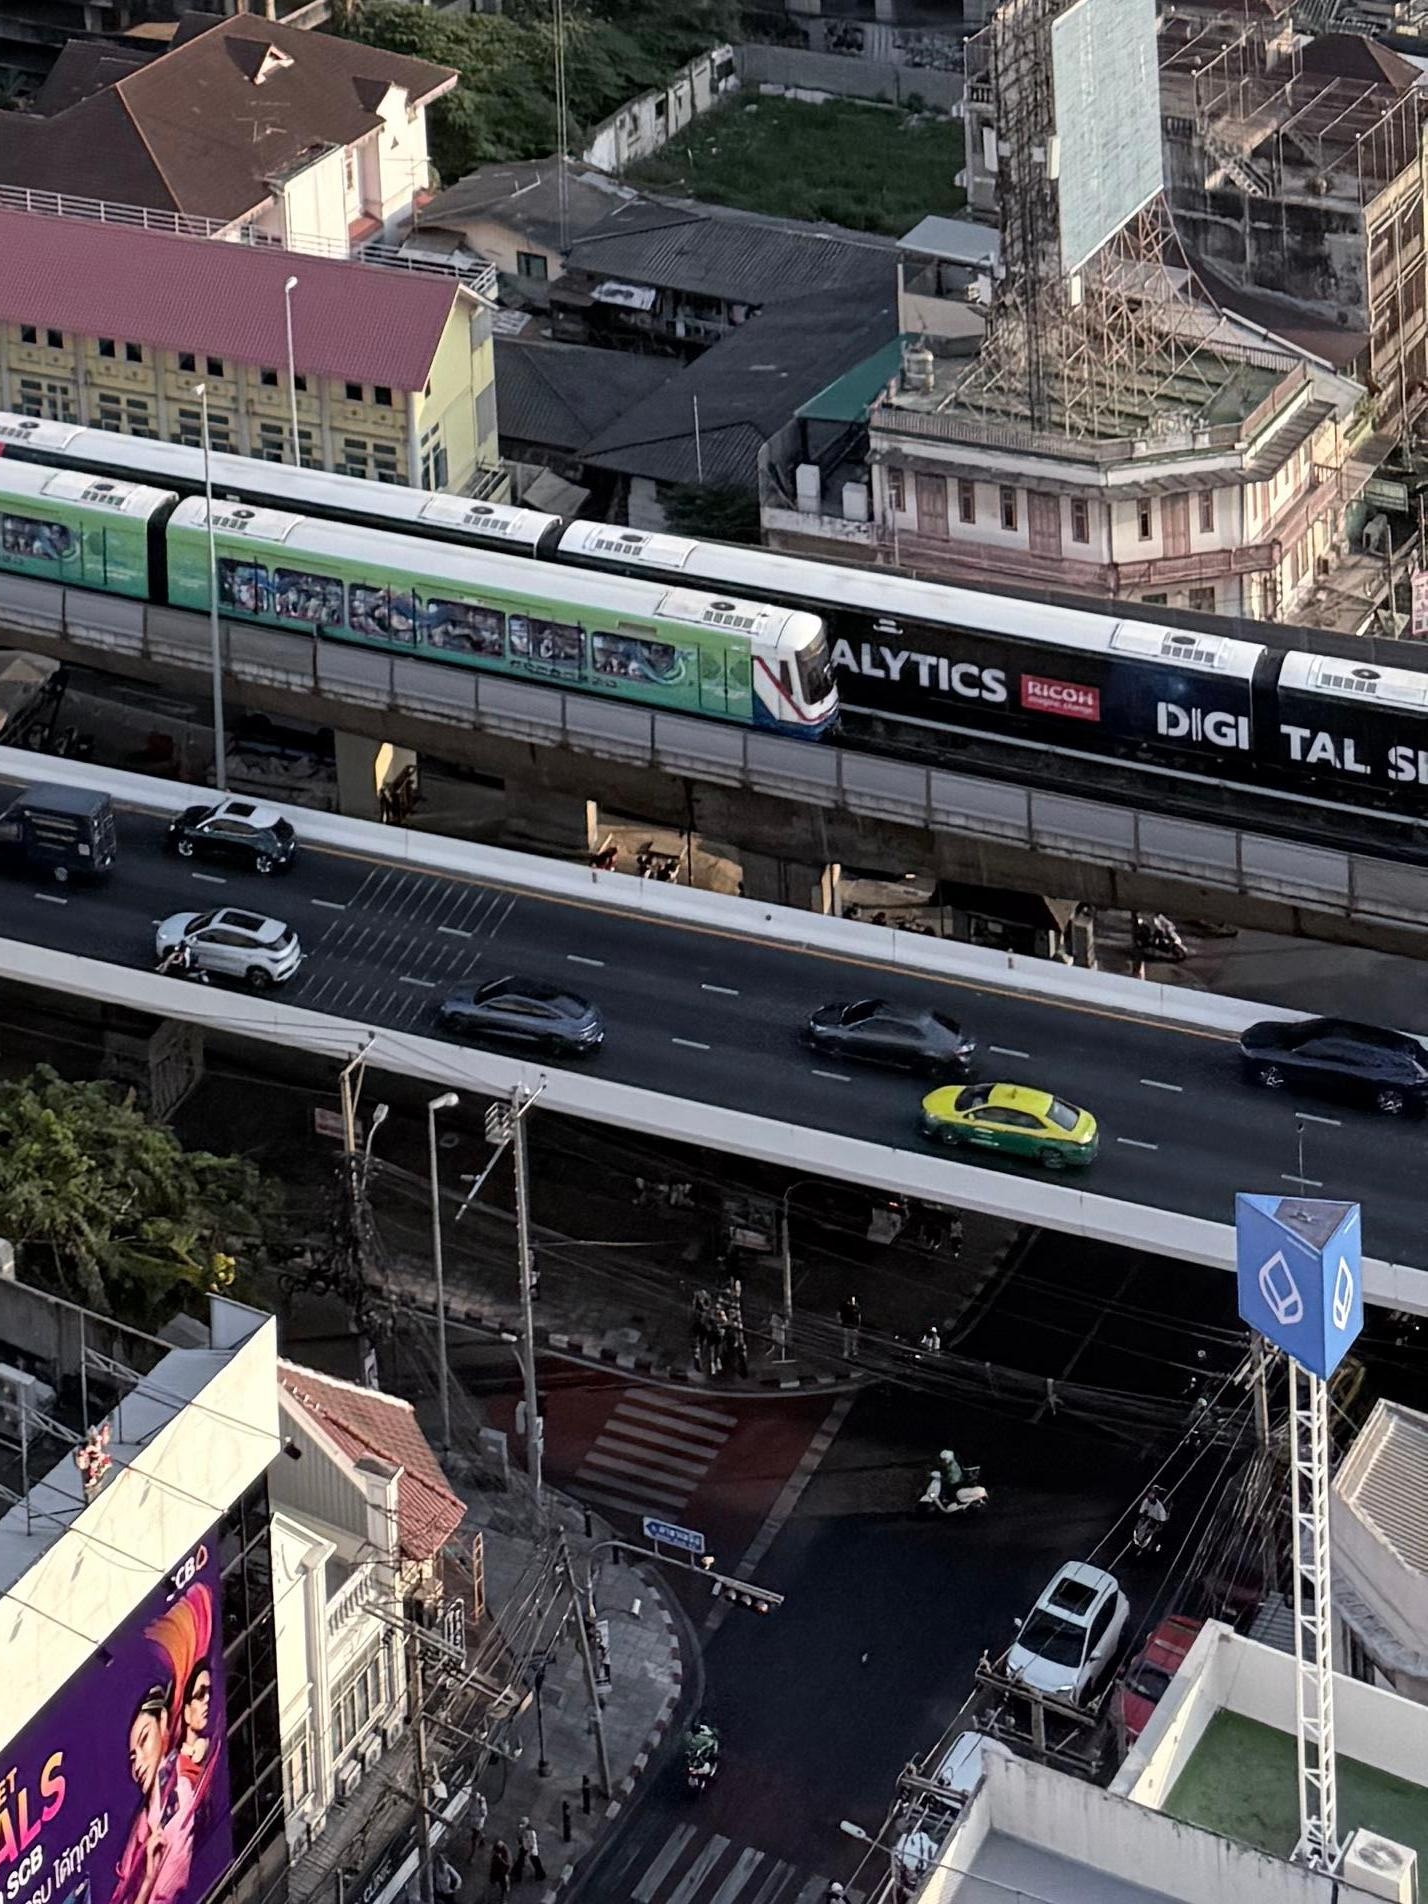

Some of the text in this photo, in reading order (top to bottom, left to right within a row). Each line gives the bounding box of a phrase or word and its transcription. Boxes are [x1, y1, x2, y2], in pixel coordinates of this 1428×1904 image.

[1027, 680, 1094, 706] RICOH
[6, 1844, 44, 1901] SCB
[52, 1812, 109, 1889] ได้ทุกวัน
